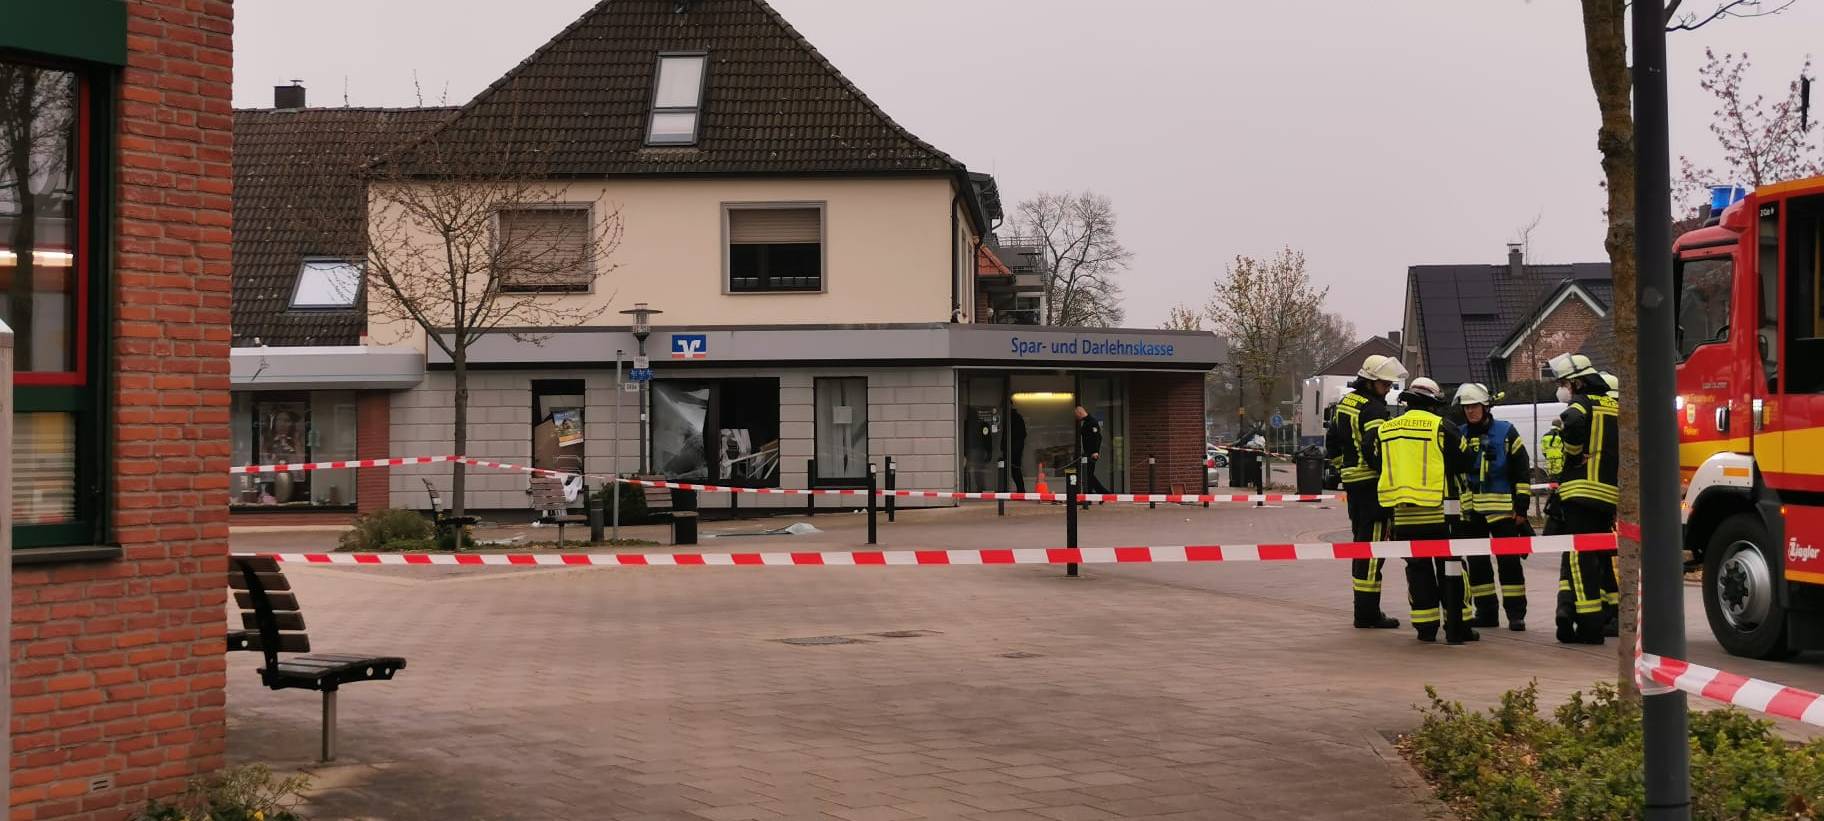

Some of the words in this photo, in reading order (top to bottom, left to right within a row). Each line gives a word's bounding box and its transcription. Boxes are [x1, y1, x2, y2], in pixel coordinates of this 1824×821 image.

[1011, 337, 1047, 357] Spar-
[1052, 338, 1077, 354] und
[1082, 339, 1174, 356] Darlehnskasse
